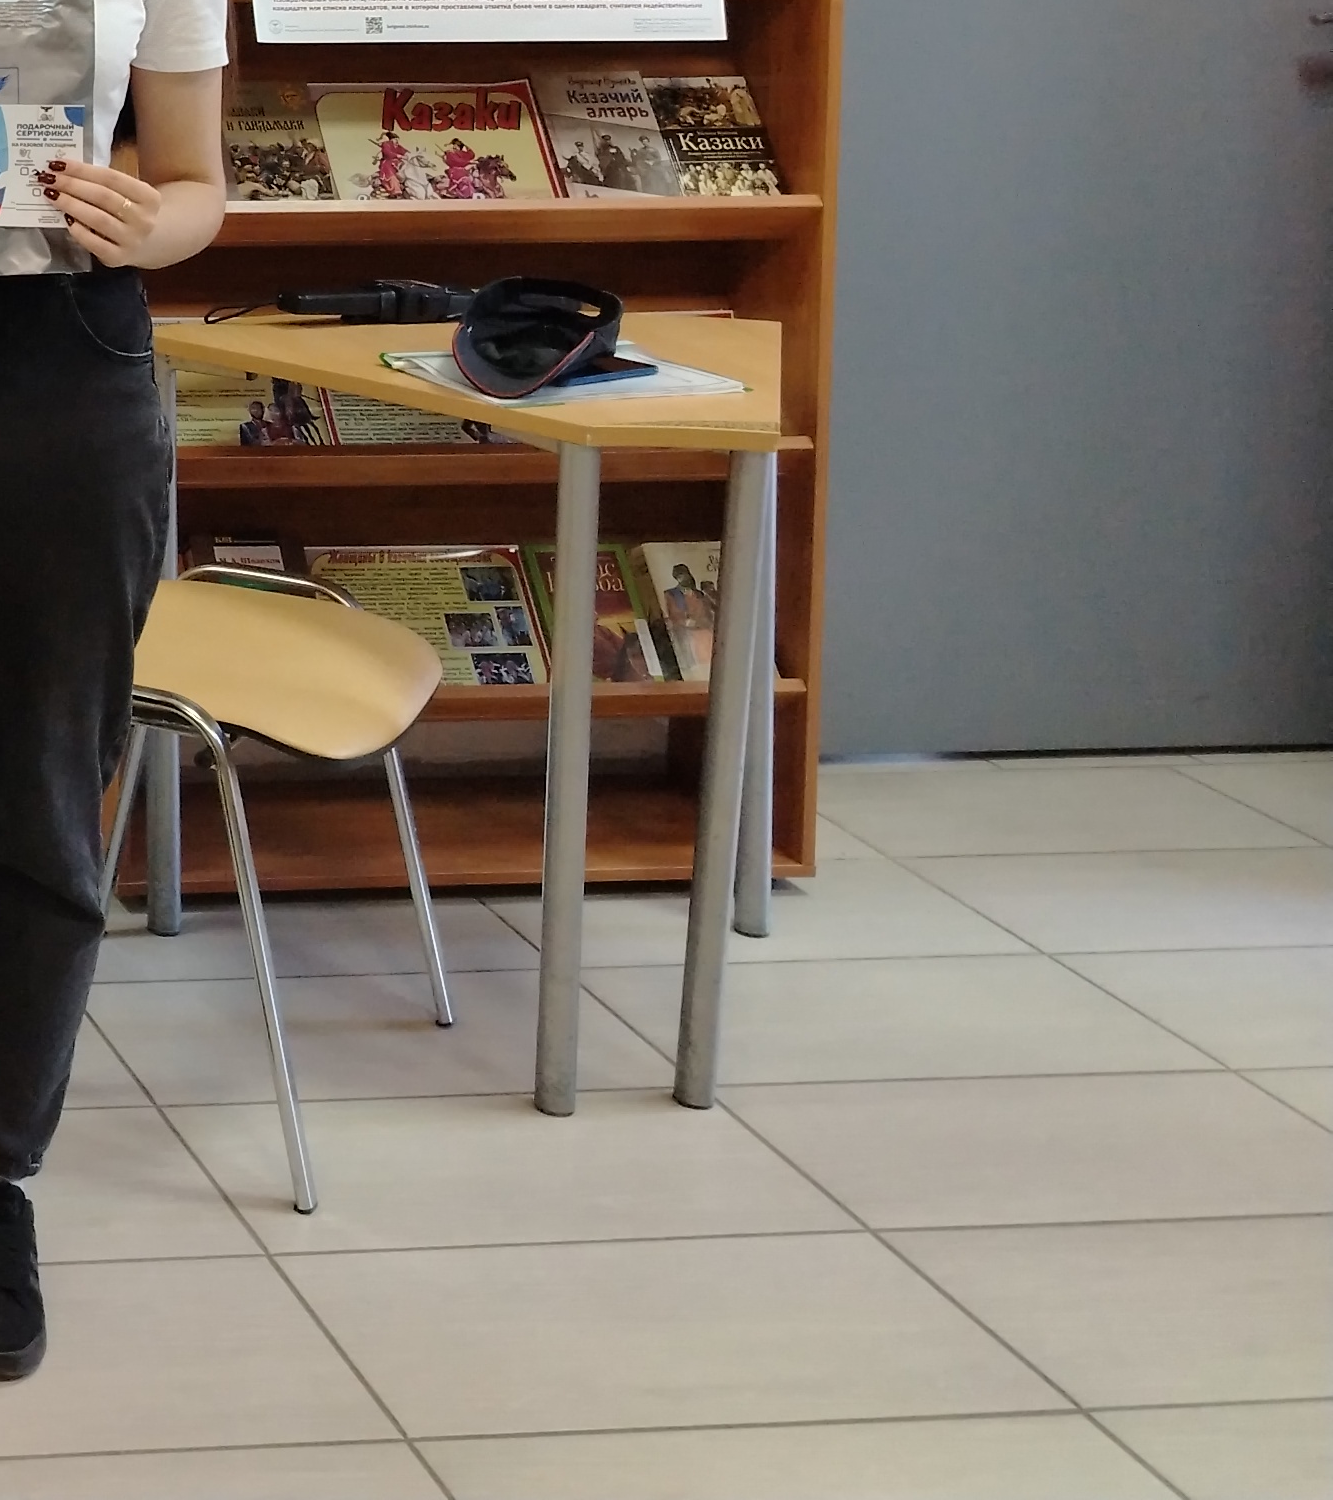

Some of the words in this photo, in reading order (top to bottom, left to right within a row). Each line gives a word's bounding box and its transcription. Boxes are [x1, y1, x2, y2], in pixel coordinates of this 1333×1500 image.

[566, 87, 645, 105] Казачий
[381, 87, 523, 132] Казаки
[586, 104, 650, 121] алтарь
[16, 122, 75, 131] ПОДАРОЧНЫЙ
[677, 132, 765, 151] Казаки
